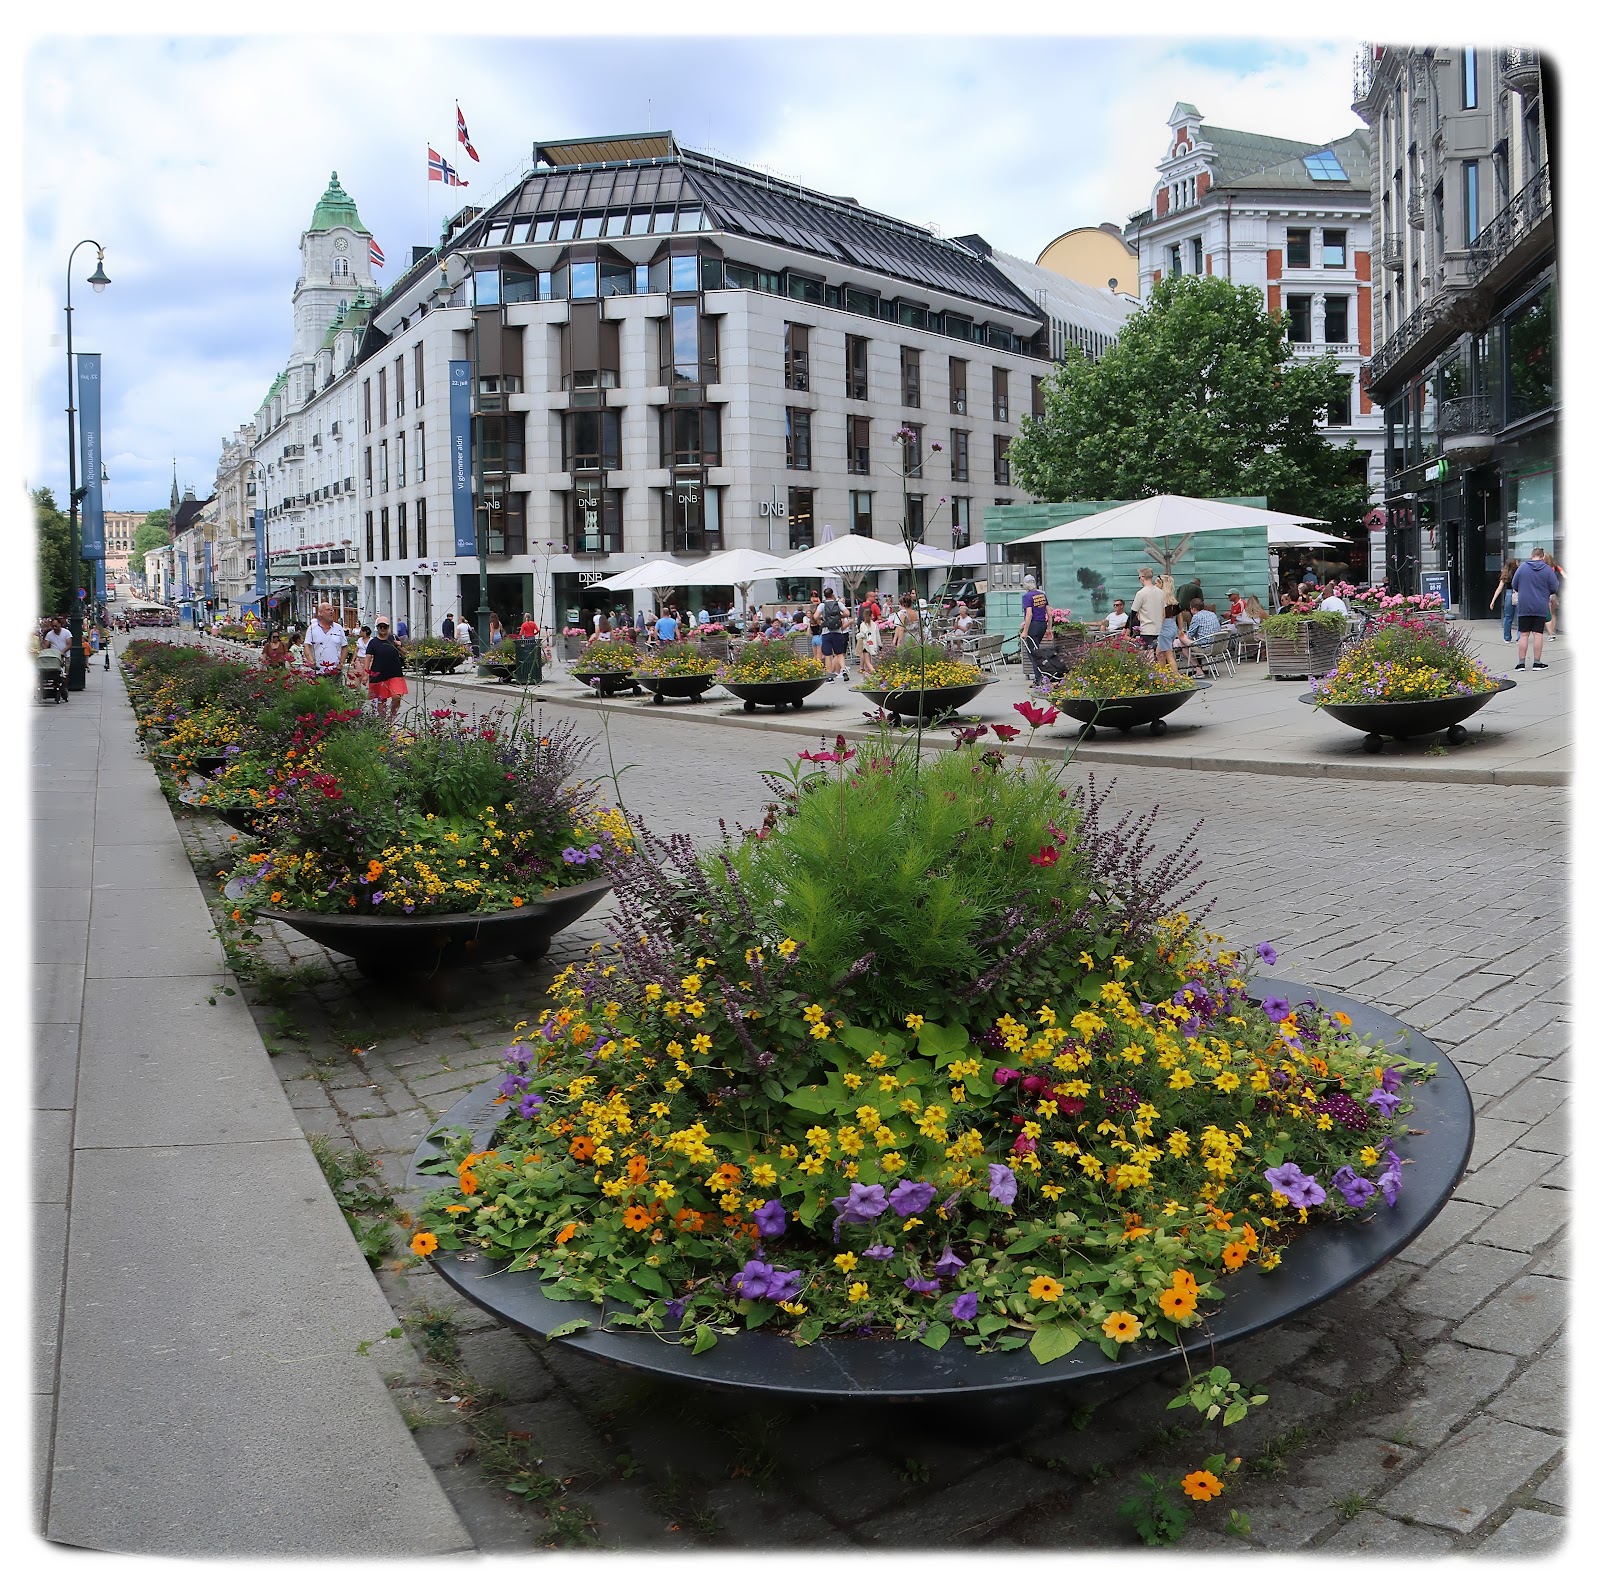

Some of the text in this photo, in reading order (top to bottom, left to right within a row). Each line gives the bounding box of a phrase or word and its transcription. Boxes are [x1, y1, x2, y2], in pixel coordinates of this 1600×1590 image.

[678, 495, 697, 503] DNB
[760, 502, 785, 516] DNB
[578, 573, 602, 582] DNB
